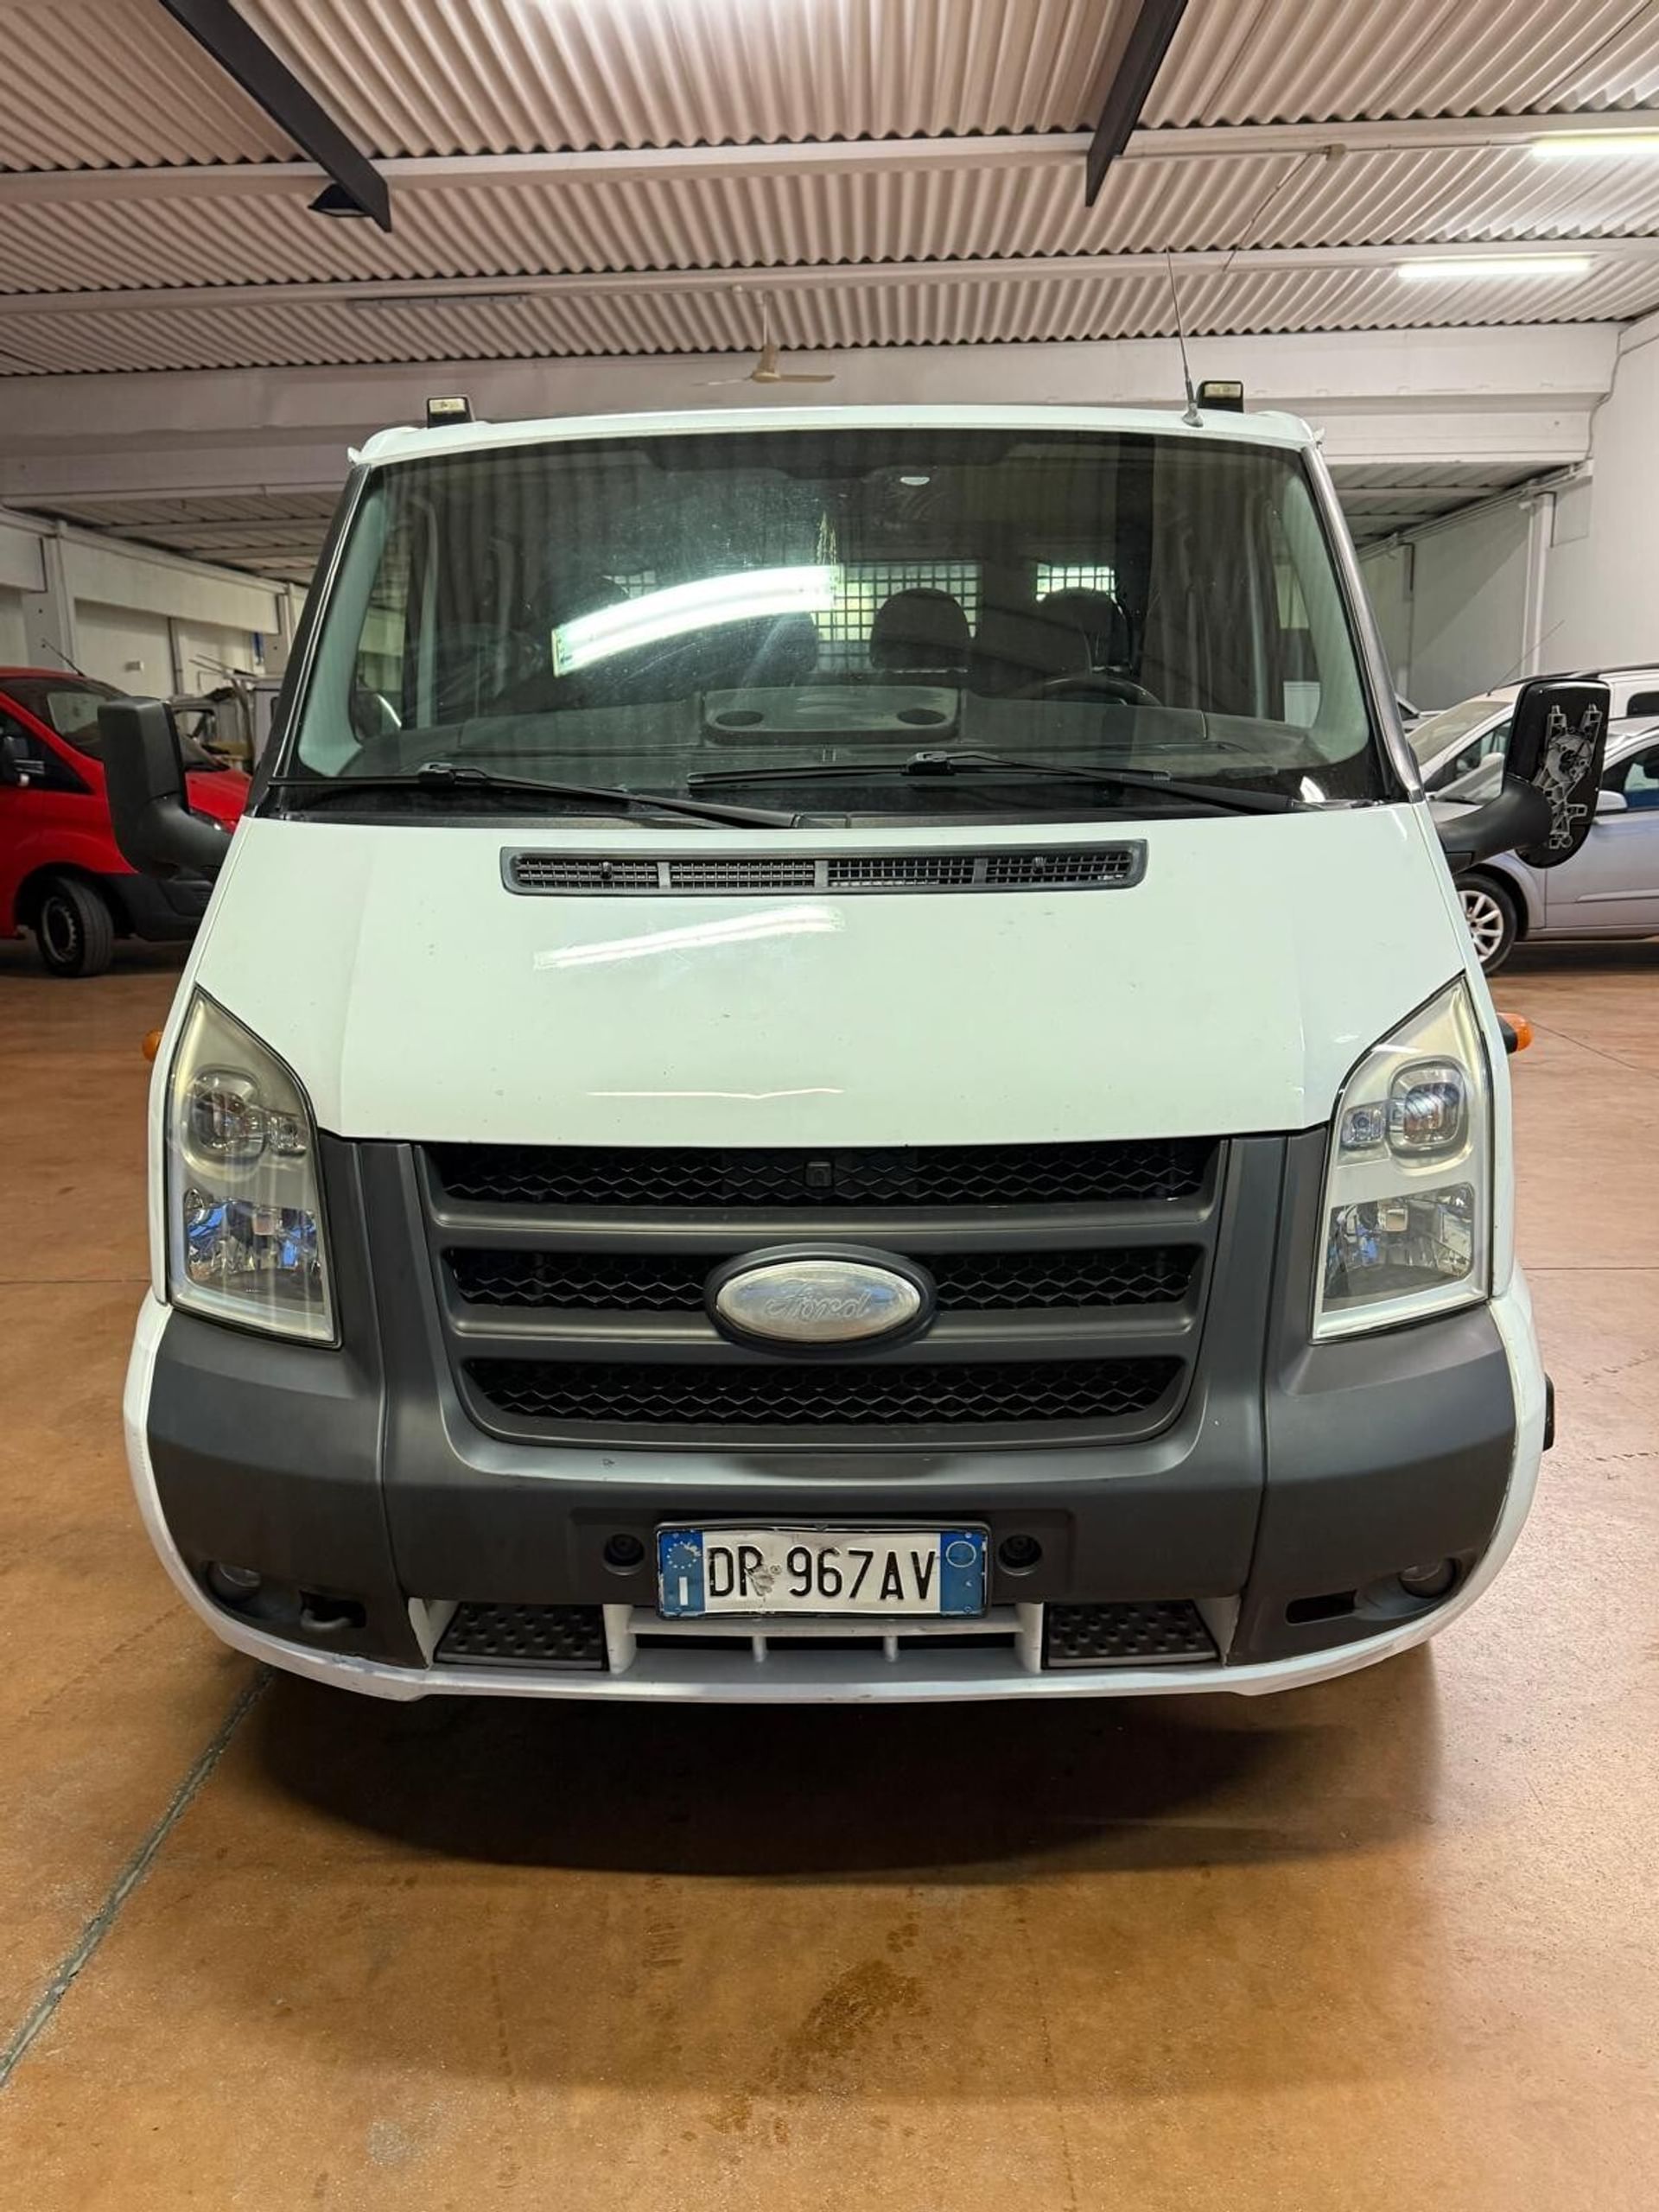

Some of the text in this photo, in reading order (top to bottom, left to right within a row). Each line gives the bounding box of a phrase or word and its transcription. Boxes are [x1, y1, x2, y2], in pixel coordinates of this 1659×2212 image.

[766, 1279, 873, 1321] Ford
[678, 1576, 689, 1606] I
[786, 1546, 937, 1600] 967AV
